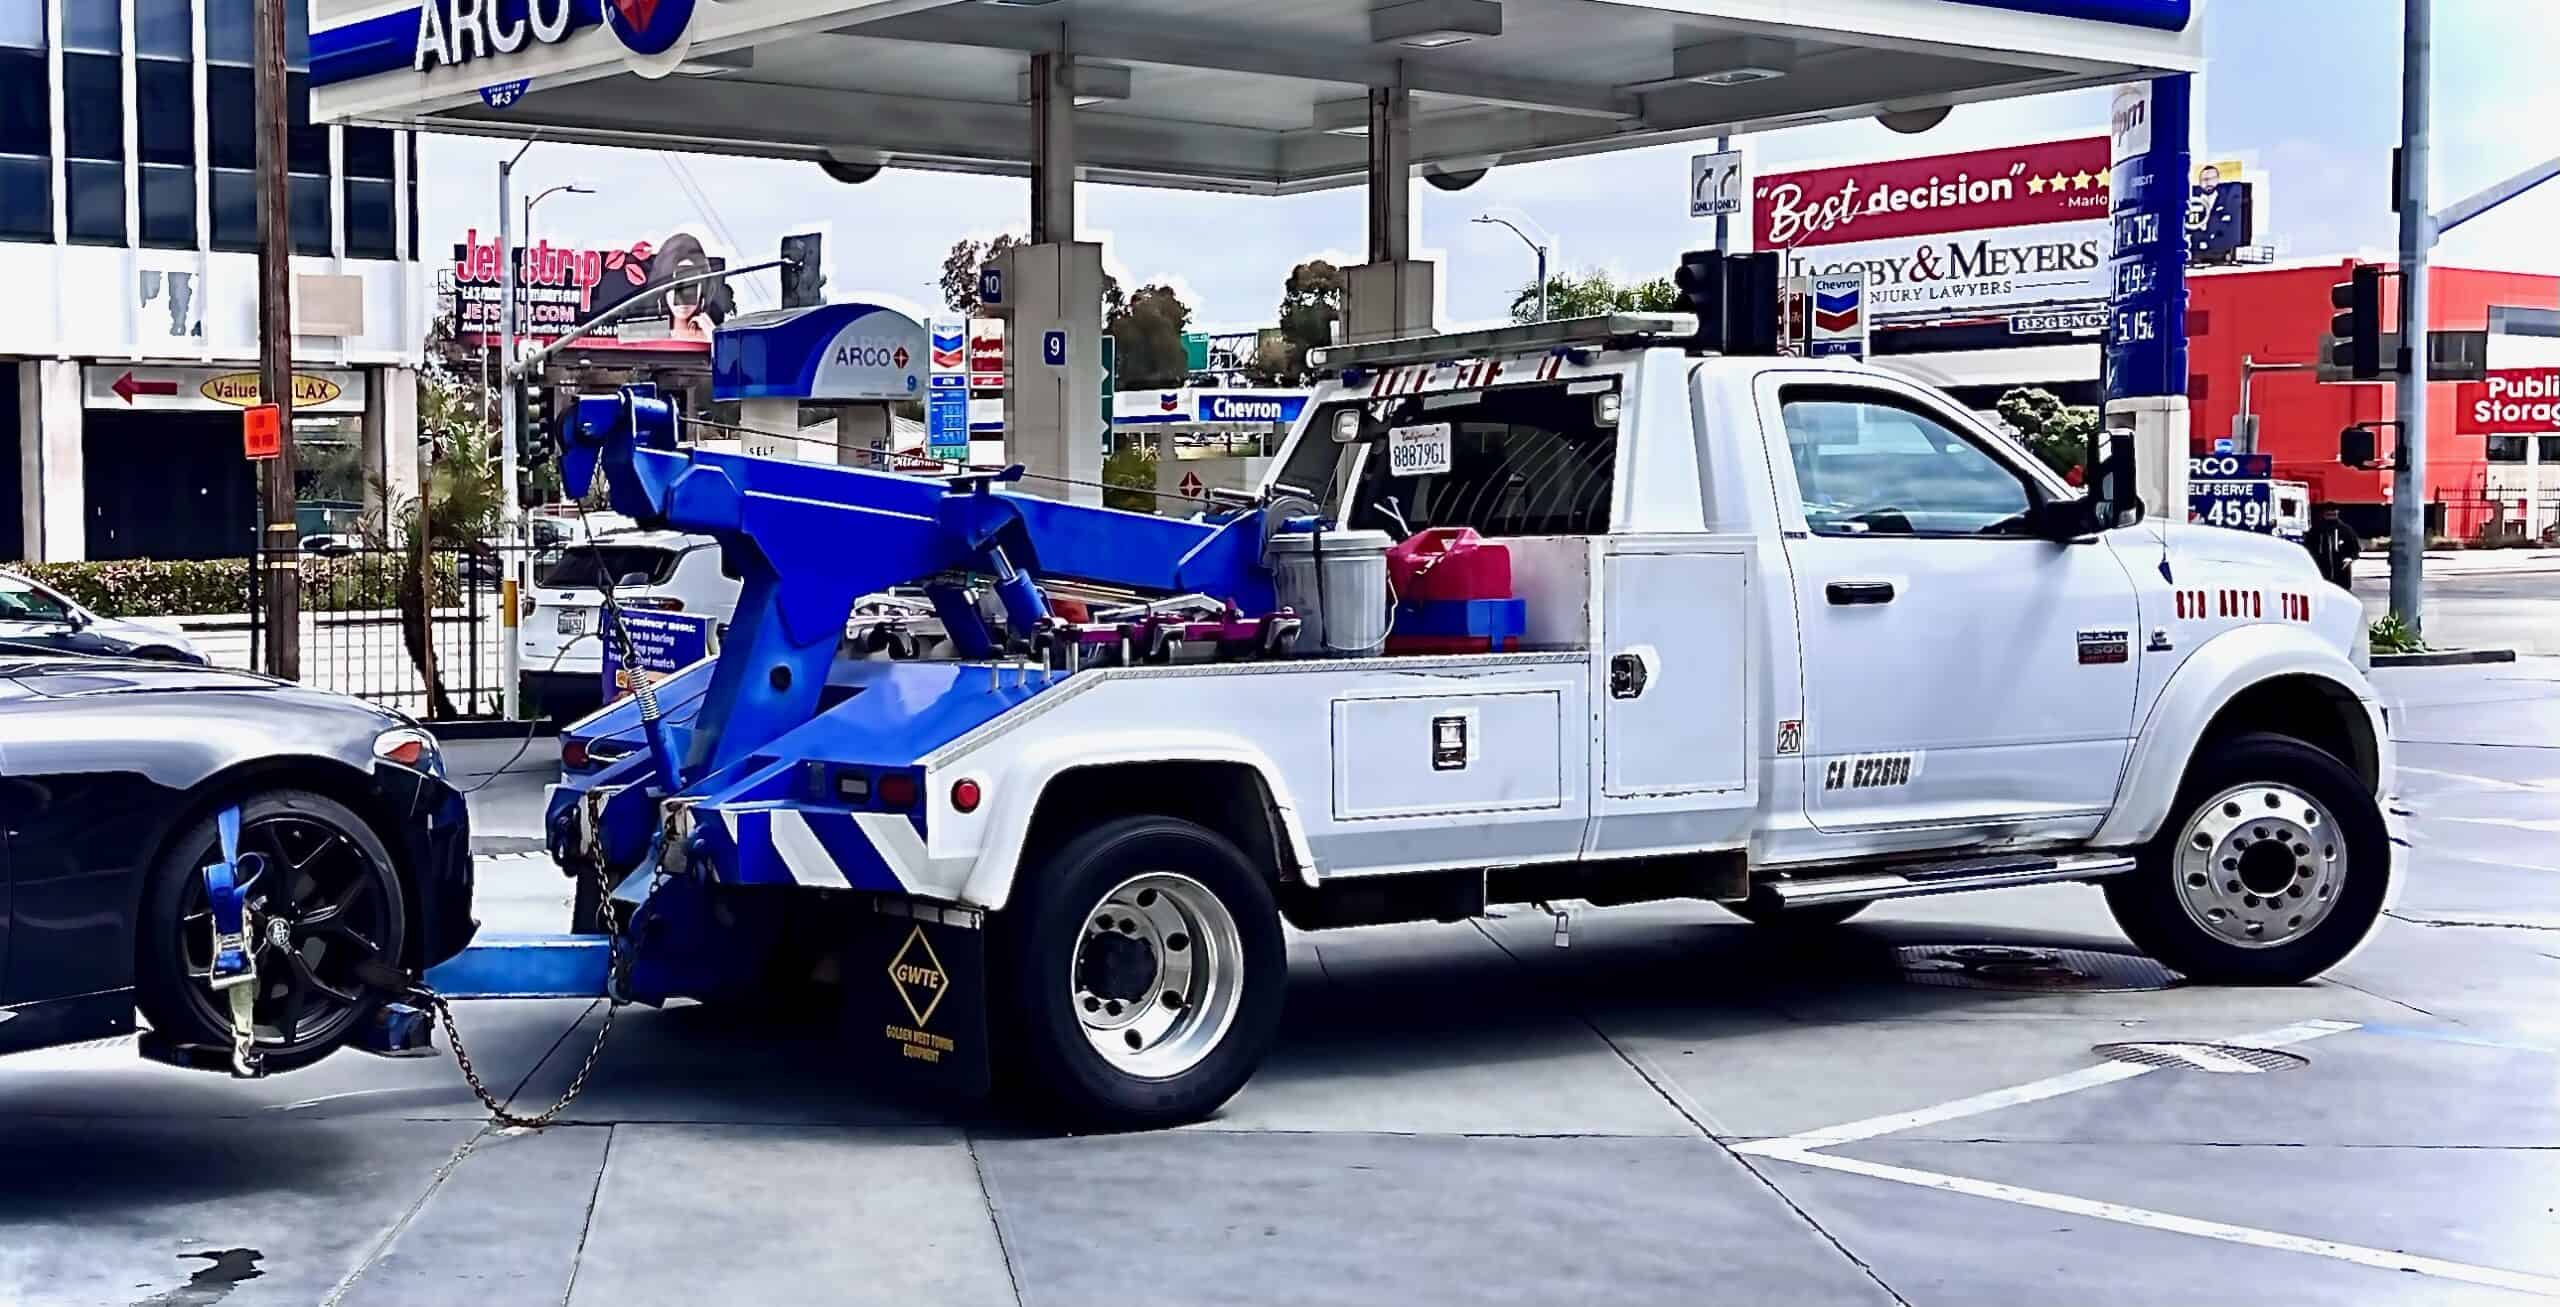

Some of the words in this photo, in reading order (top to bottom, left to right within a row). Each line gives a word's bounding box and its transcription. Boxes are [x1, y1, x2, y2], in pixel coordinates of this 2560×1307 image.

[414, 0, 570, 71] ARCO
[1694, 201, 1714, 212] ONLY
[1717, 198, 1738, 209] ONLY
[984, 275, 1000, 294] 10
[1815, 280, 1860, 291] Chevron
[1869, 287, 1923, 304] NJURY
[1929, 280, 2012, 300] LAWYERS
[2017, 312, 2110, 330] REGENCY
[1050, 338, 1060, 357] 9
[836, 347, 891, 367] ARCO
[213, 381, 258, 399] Value
[294, 383, 329, 399] LAX
[906, 375, 917, 391] 9
[1213, 397, 1282, 418] Chevron
[748, 445, 775, 457] SELF
[2188, 457, 2239, 475] RCO
[2188, 484, 2211, 496] ELF
[2213, 484, 2254, 496] SERVE
[1780, 729, 1800, 751] 20
[1825, 760, 1847, 790] CA
[897, 963, 939, 988] GWTE
